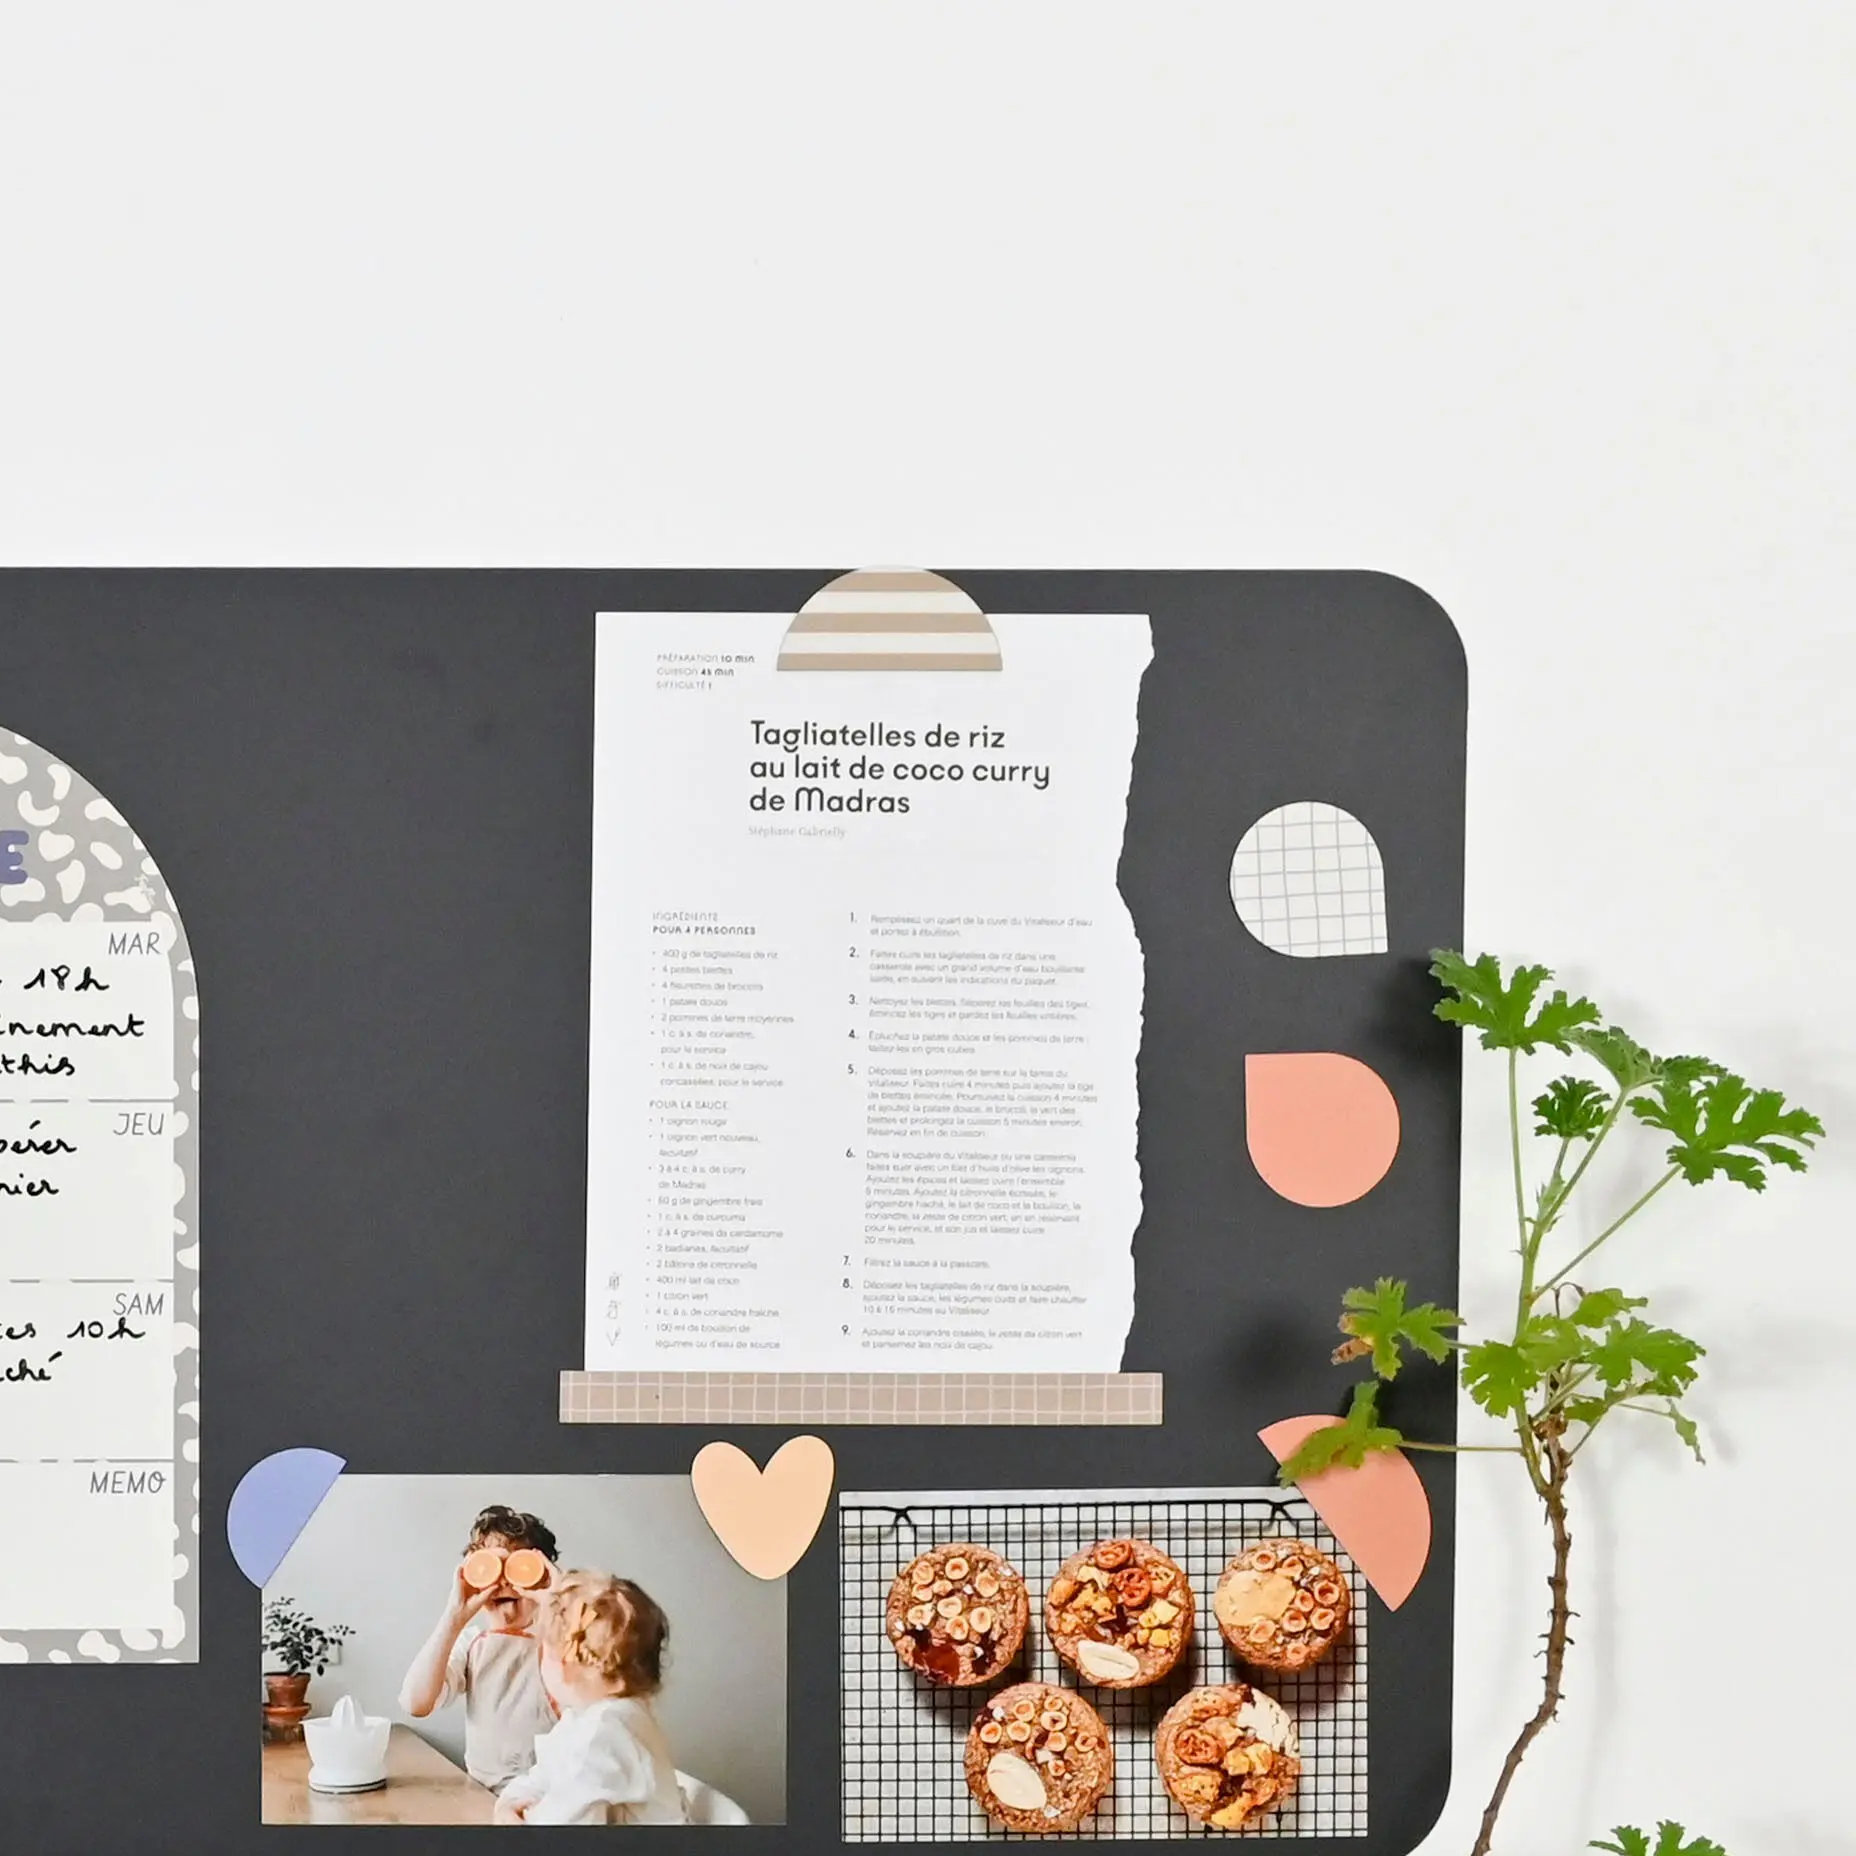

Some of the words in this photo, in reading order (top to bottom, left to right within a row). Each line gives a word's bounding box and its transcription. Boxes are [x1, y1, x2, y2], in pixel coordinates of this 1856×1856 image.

[750, 719, 916, 754] Tagliatelles
[924, 722, 961, 748] de
[969, 724, 1005, 749] riz
[750, 761, 784, 779] au
[793, 755, 842, 780] lait
[848, 754, 885, 780] de
[892, 763, 964, 782] coco
[972, 764, 1050, 790] curry
[749, 786, 786, 812] de
[794, 786, 910, 814] Madras
[652, 923, 682, 934] POUR
[107, 931, 162, 956] MAR
[112, 1111, 165, 1137] JEU
[112, 1292, 165, 1316] SAM
[89, 1469, 168, 1495] MEMO
